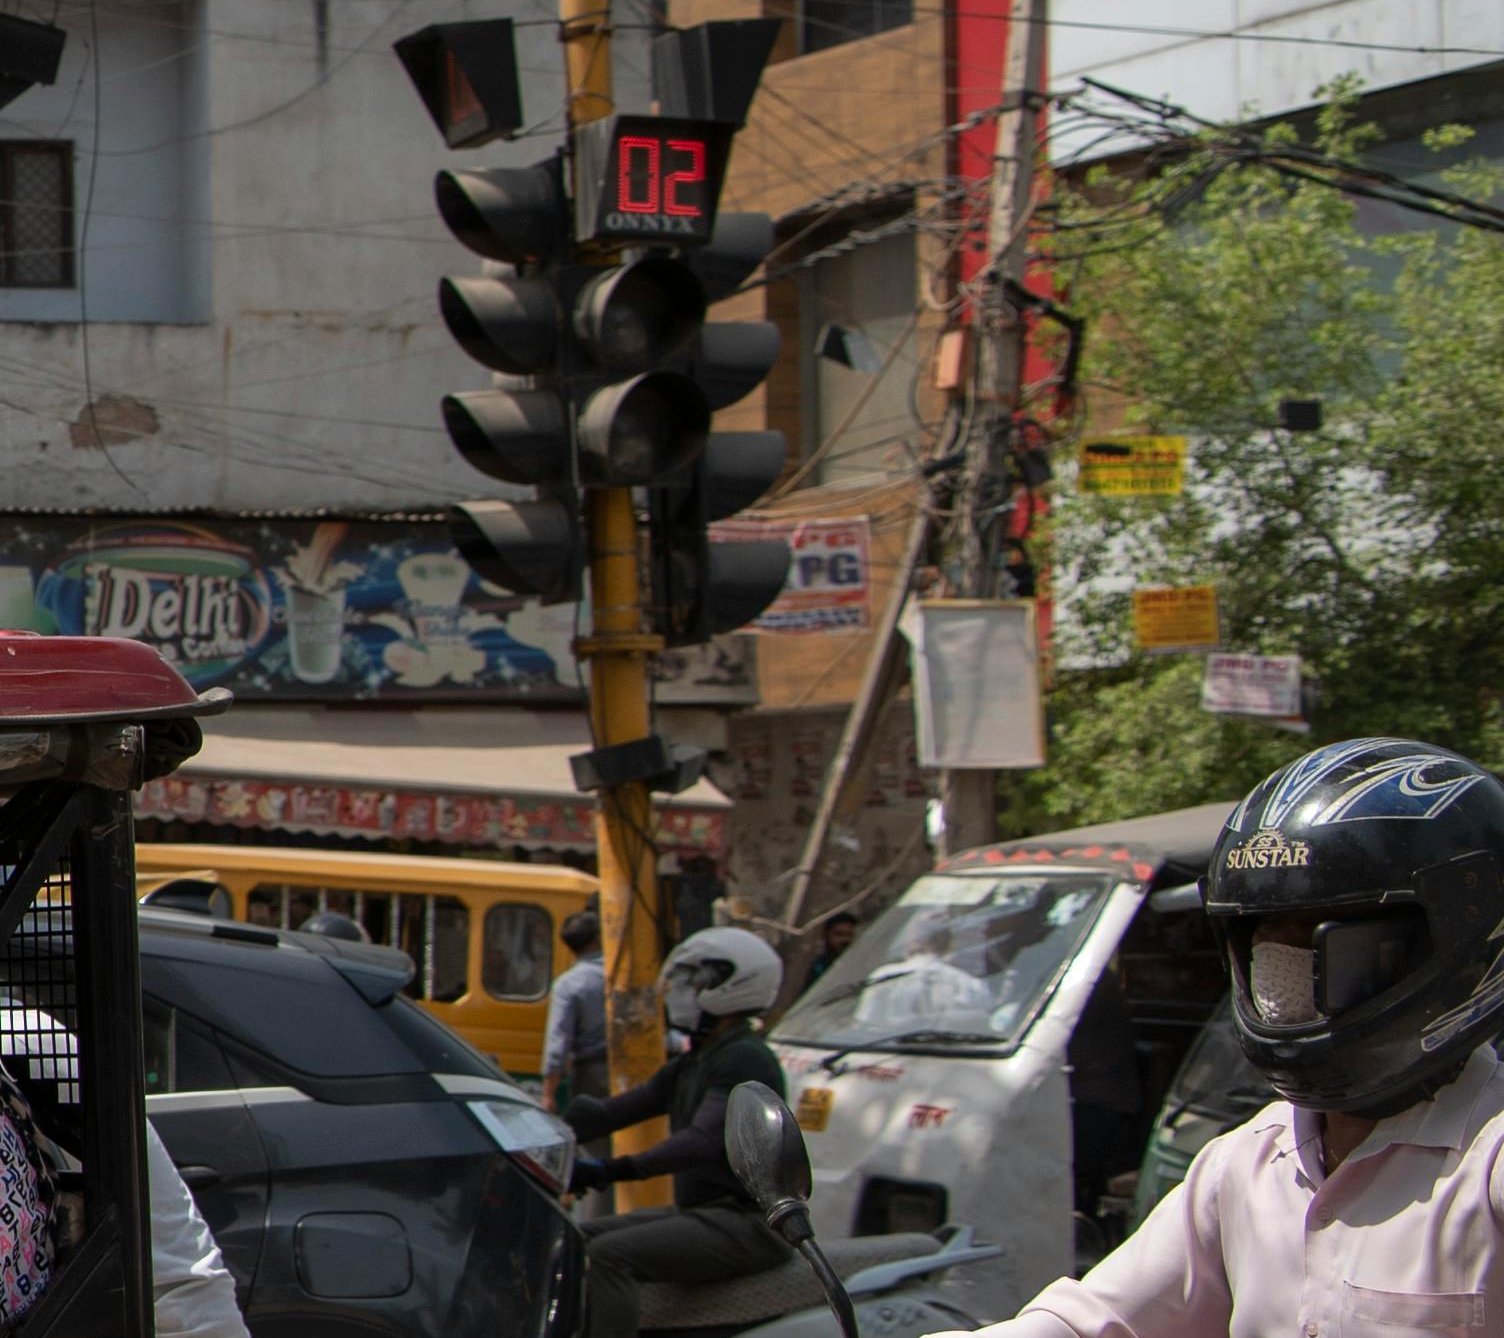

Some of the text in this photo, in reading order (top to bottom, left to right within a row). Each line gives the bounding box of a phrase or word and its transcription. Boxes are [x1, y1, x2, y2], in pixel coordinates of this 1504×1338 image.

[618, 136, 705, 216] 02
[605, 213, 695, 233] ONNYX
[799, 552, 861, 588] PG
[96, 565, 240, 638] Delhi
[1226, 847, 1310, 869] SUNSTAR
